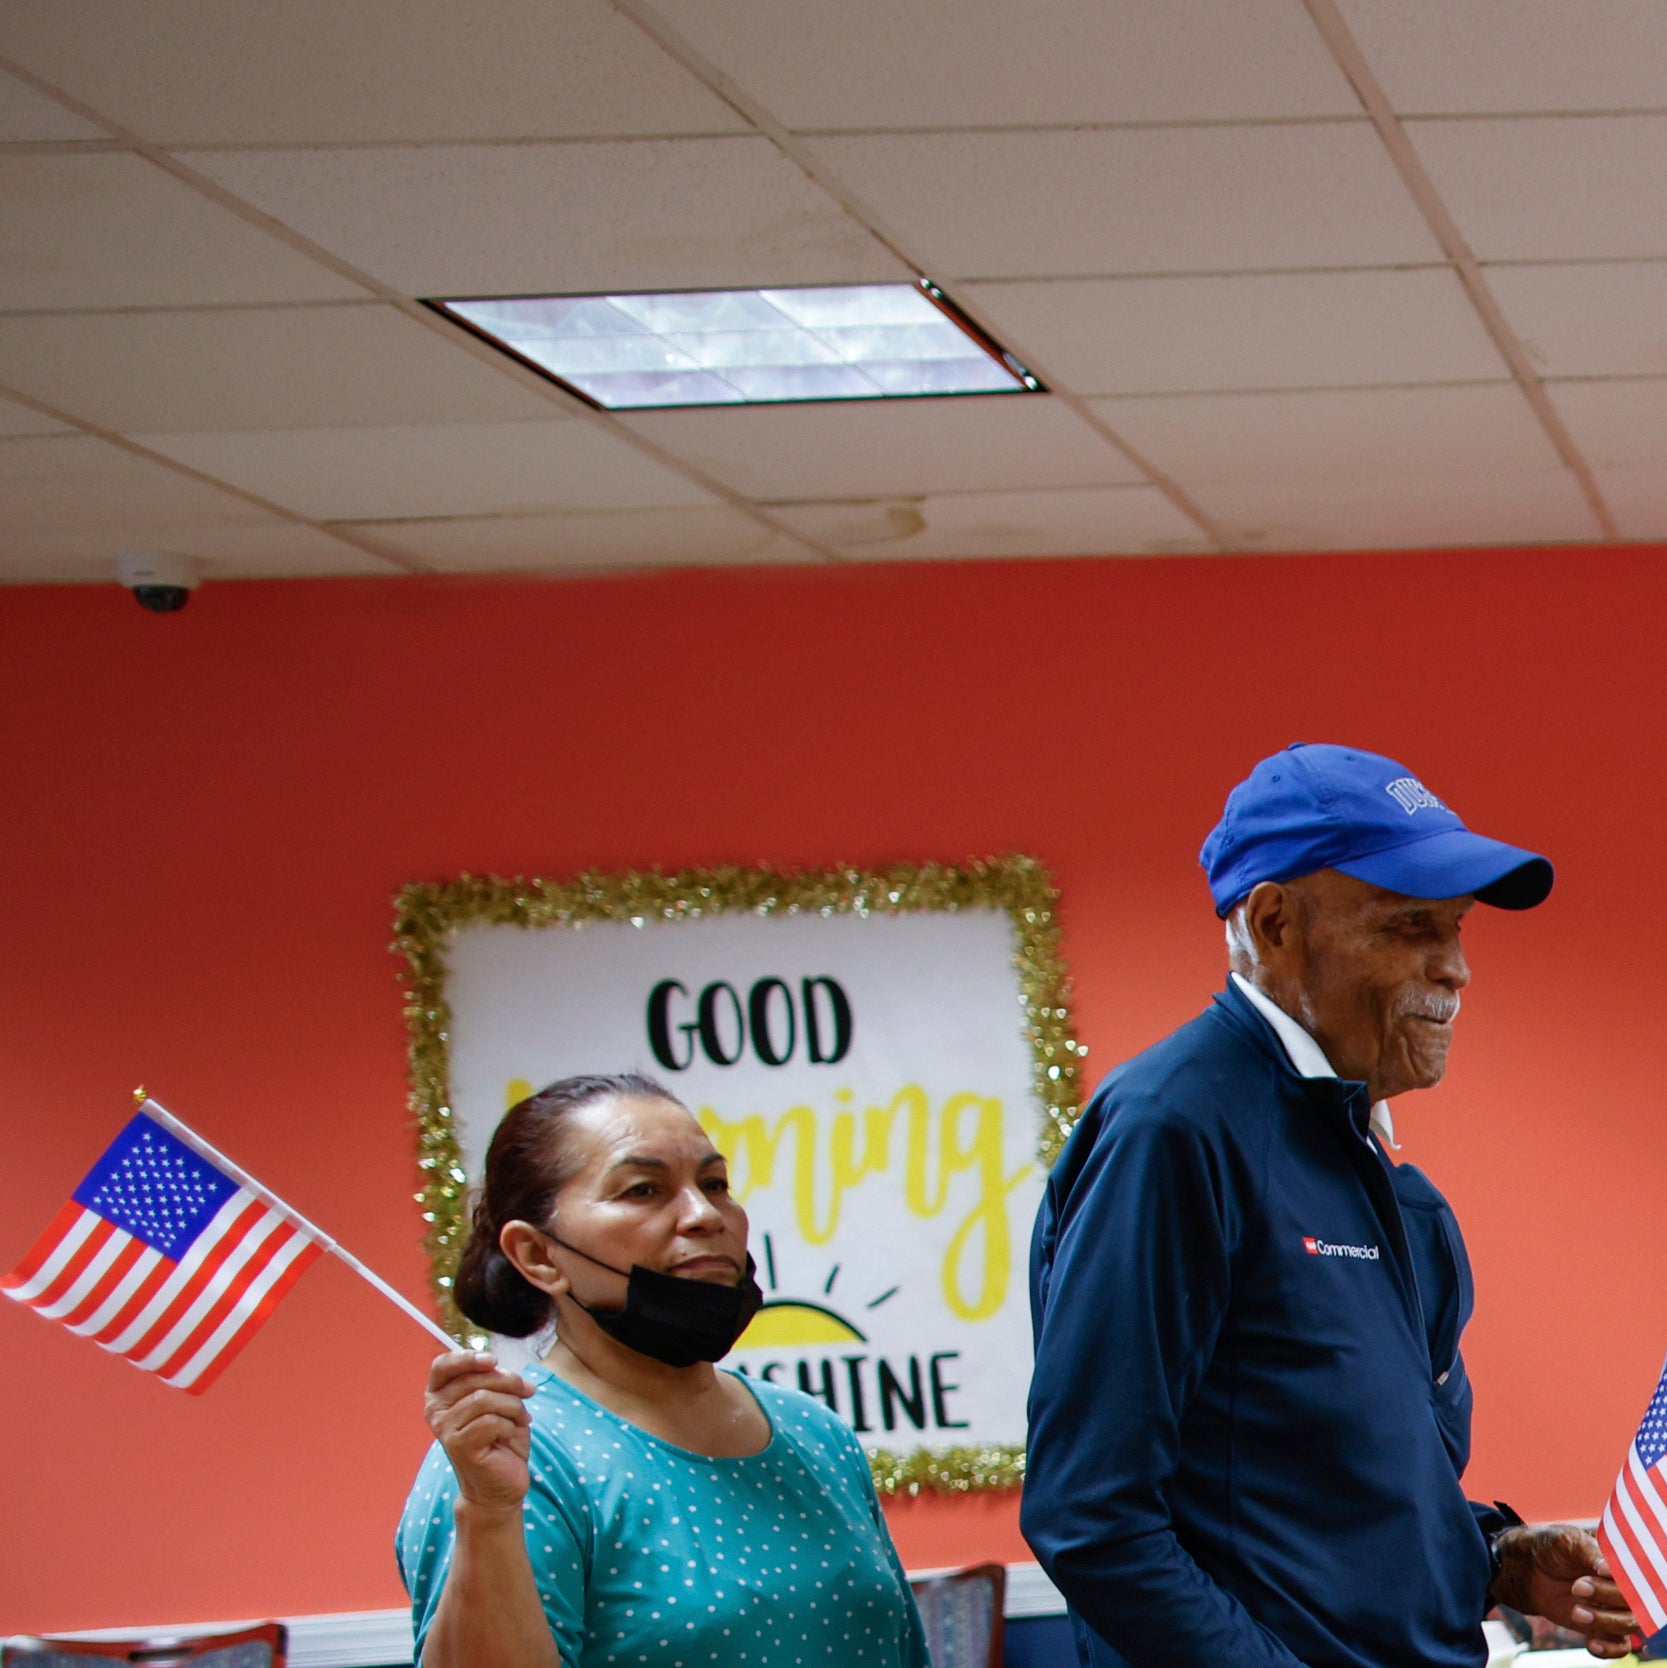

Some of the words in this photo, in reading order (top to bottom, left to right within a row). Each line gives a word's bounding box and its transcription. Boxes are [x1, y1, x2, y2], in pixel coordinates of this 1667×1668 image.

[646, 974, 853, 1072] GOOD
[507, 1079, 1035, 1323] rning
[1317, 1239, 1380, 1260] Commercial
[738, 1351, 971, 1433] HINE
